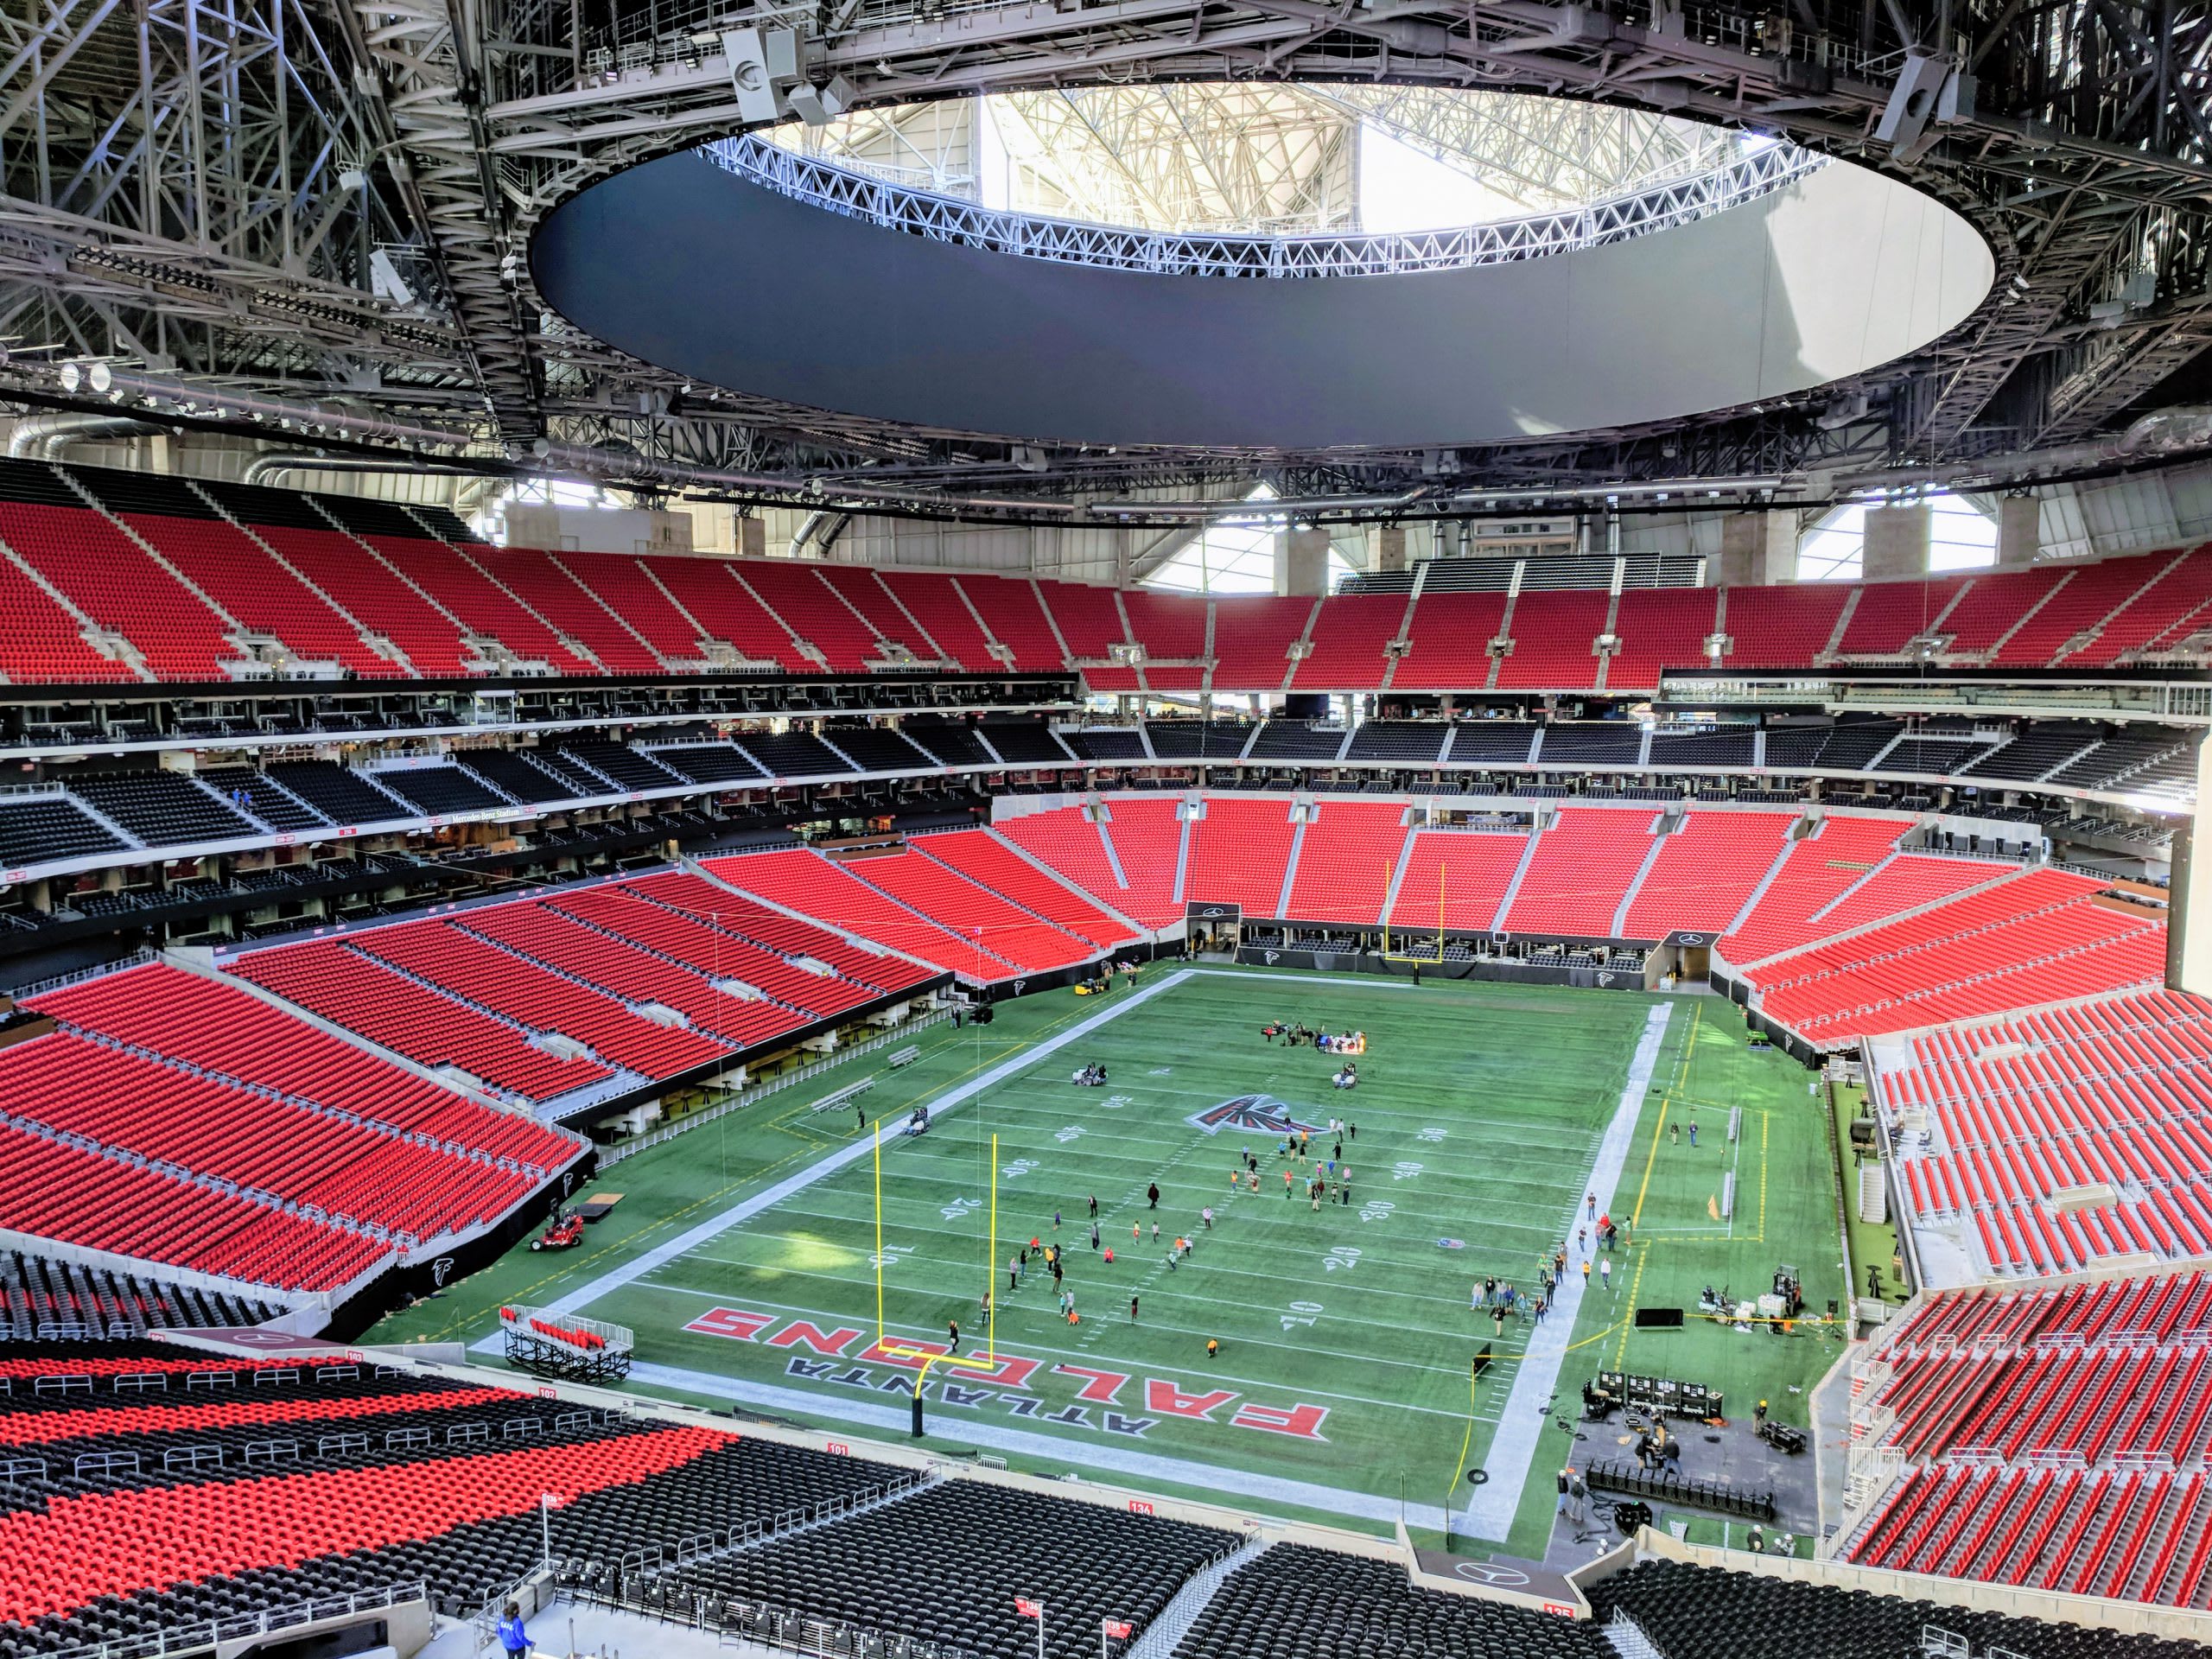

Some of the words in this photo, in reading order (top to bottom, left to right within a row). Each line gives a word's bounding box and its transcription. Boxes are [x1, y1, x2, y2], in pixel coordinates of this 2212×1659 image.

[452, 811, 495, 823] Mercedes-Benz
[496, 808, 519, 818] Stadium
[940, 1198, 982, 1216] 20
[1358, 1201, 1395, 1219] 30
[1323, 1247, 1363, 1268] 20
[1279, 1301, 1325, 1326] 10
[349, 1352, 363, 1362] 103
[681, 1306, 1331, 1442] FALCONS
[540, 1389, 555, 1399] 102
[785, 1356, 1161, 1439] ATLANTA
[830, 1444, 846, 1455] 101
[1132, 1503, 1150, 1515] 136
[1026, 1601, 1039, 1611] 136
[1108, 1621, 1121, 1630] 135
